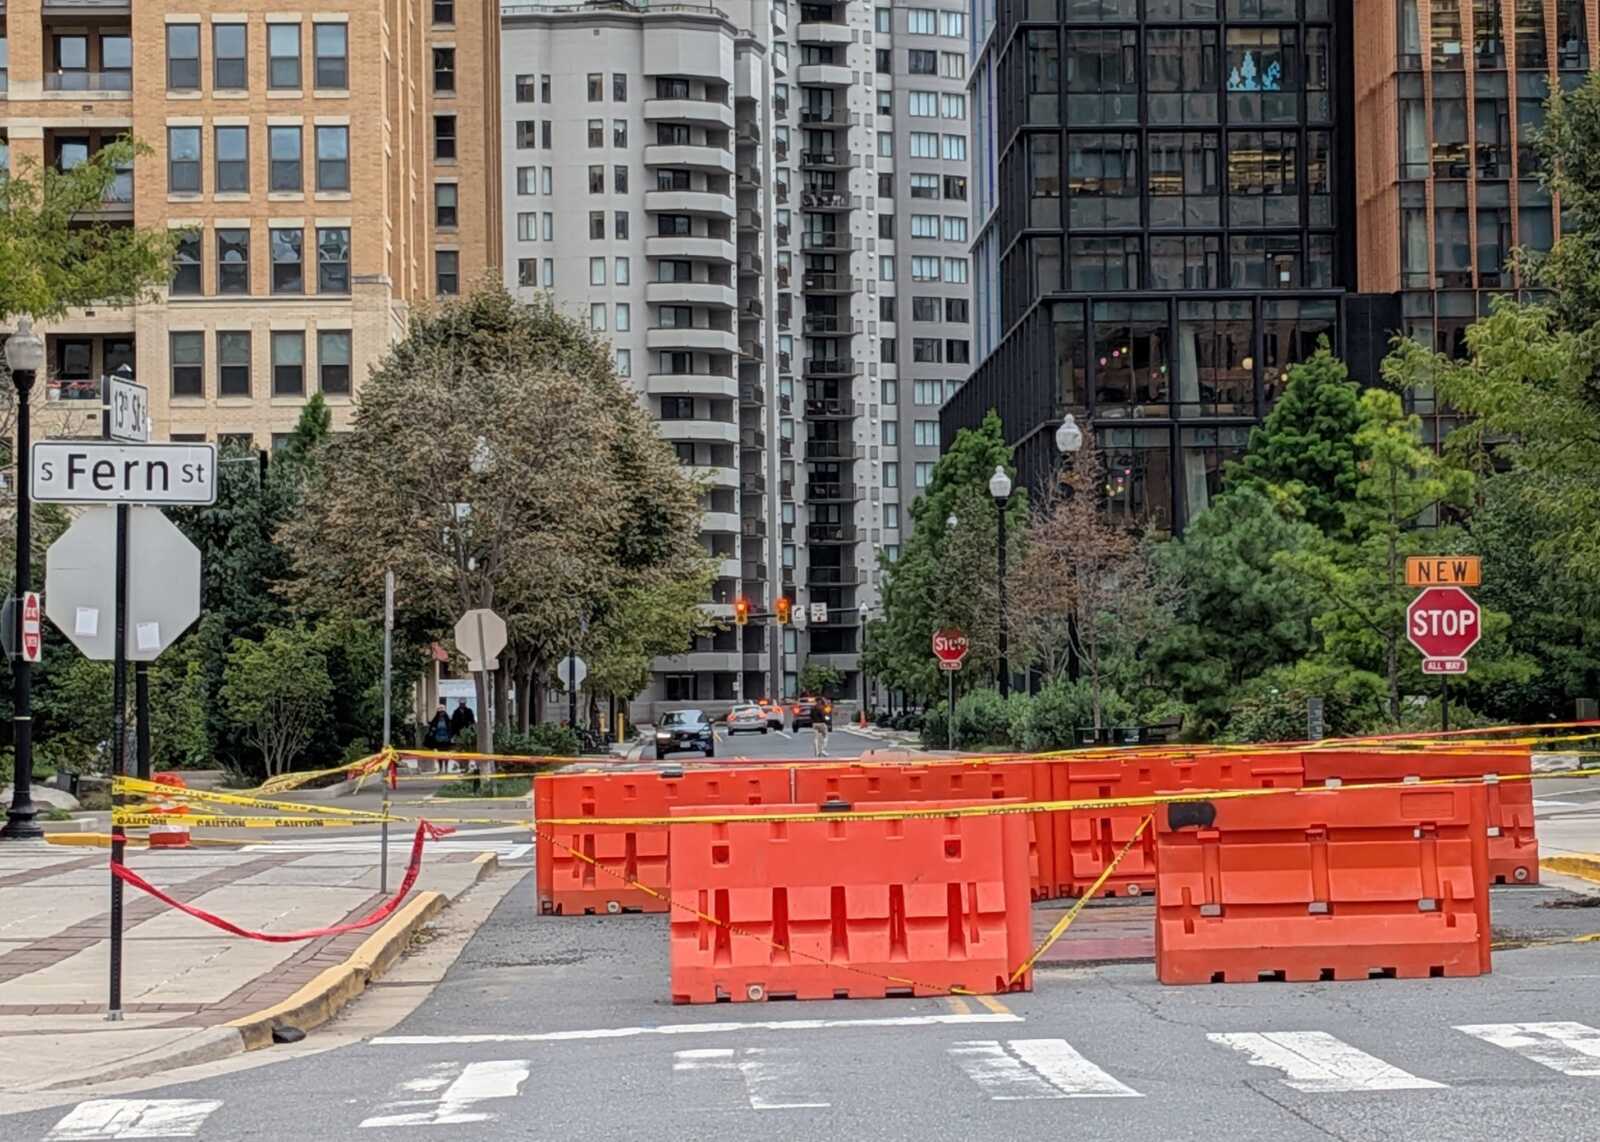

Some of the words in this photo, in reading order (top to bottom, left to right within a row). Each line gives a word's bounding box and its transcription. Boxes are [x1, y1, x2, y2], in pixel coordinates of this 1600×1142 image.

[41, 461, 53, 481] S
[67, 453, 169, 491] Fern
[181, 463, 205, 484] St
[1418, 561, 1467, 582] NEW
[1413, 609, 1475, 636] STOP
[1427, 661, 1442, 670] ALL
[117, 816, 167, 826] CAUTION
[196, 818, 246, 828] CAUTION
[275, 818, 324, 828] CAUTION
